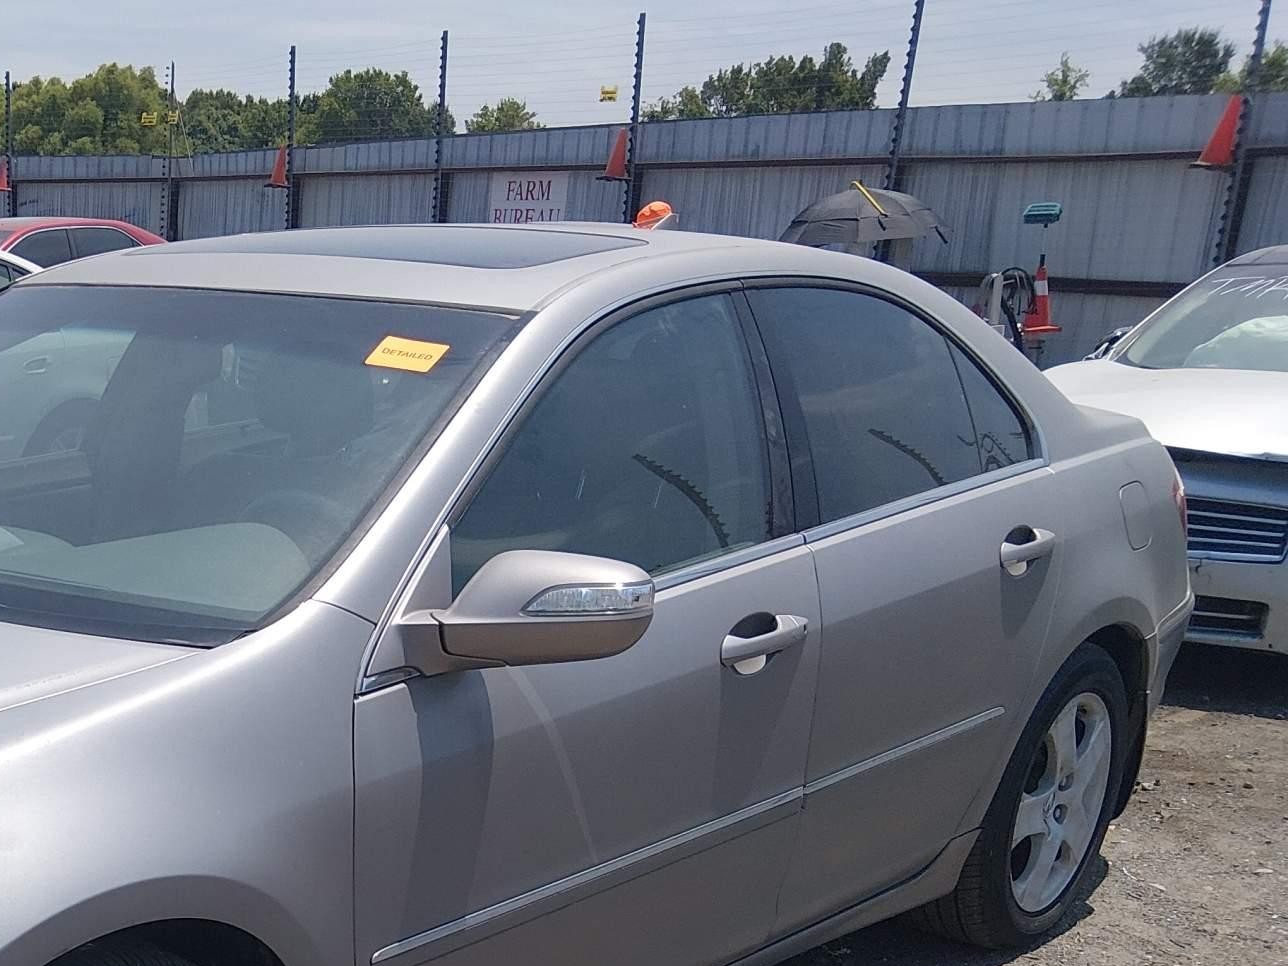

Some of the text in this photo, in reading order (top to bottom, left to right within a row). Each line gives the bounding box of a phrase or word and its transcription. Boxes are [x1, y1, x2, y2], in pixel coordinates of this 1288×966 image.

[506, 180, 552, 201] FARM
[492, 208, 561, 224] BUREAU
[381, 347, 433, 361] DETAILED
